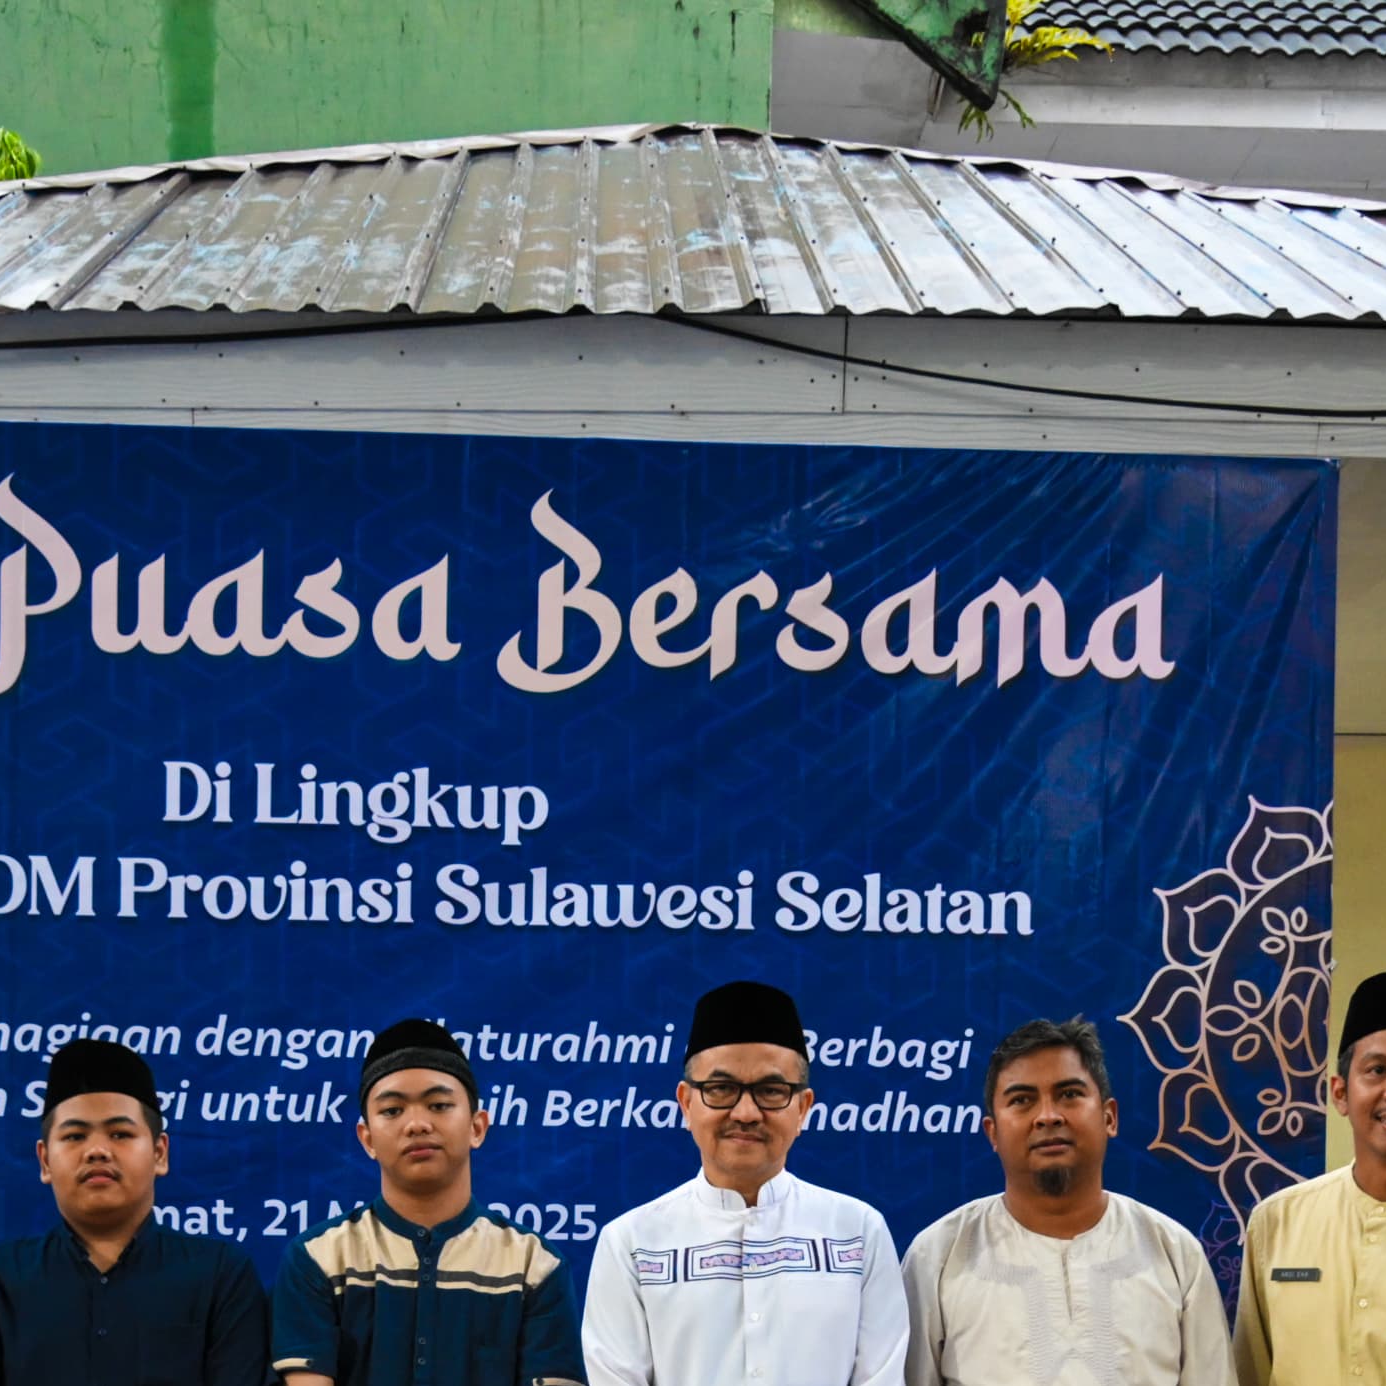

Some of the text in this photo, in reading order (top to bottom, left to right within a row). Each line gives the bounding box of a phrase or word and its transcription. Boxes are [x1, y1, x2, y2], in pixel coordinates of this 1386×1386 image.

[495, 486, 1177, 694] Bersama
[161, 760, 551, 848] Di Lingkup
[115, 858, 415, 926] Provinsi
[433, 862, 755, 932] Sulawesi
[773, 870, 1037, 938] Selatan
[194, 1014, 375, 1068] dengan
[200, 1080, 348, 1126] untuk
[542, 1085, 690, 1129] Berka
[261, 1197, 309, 1238] 21
